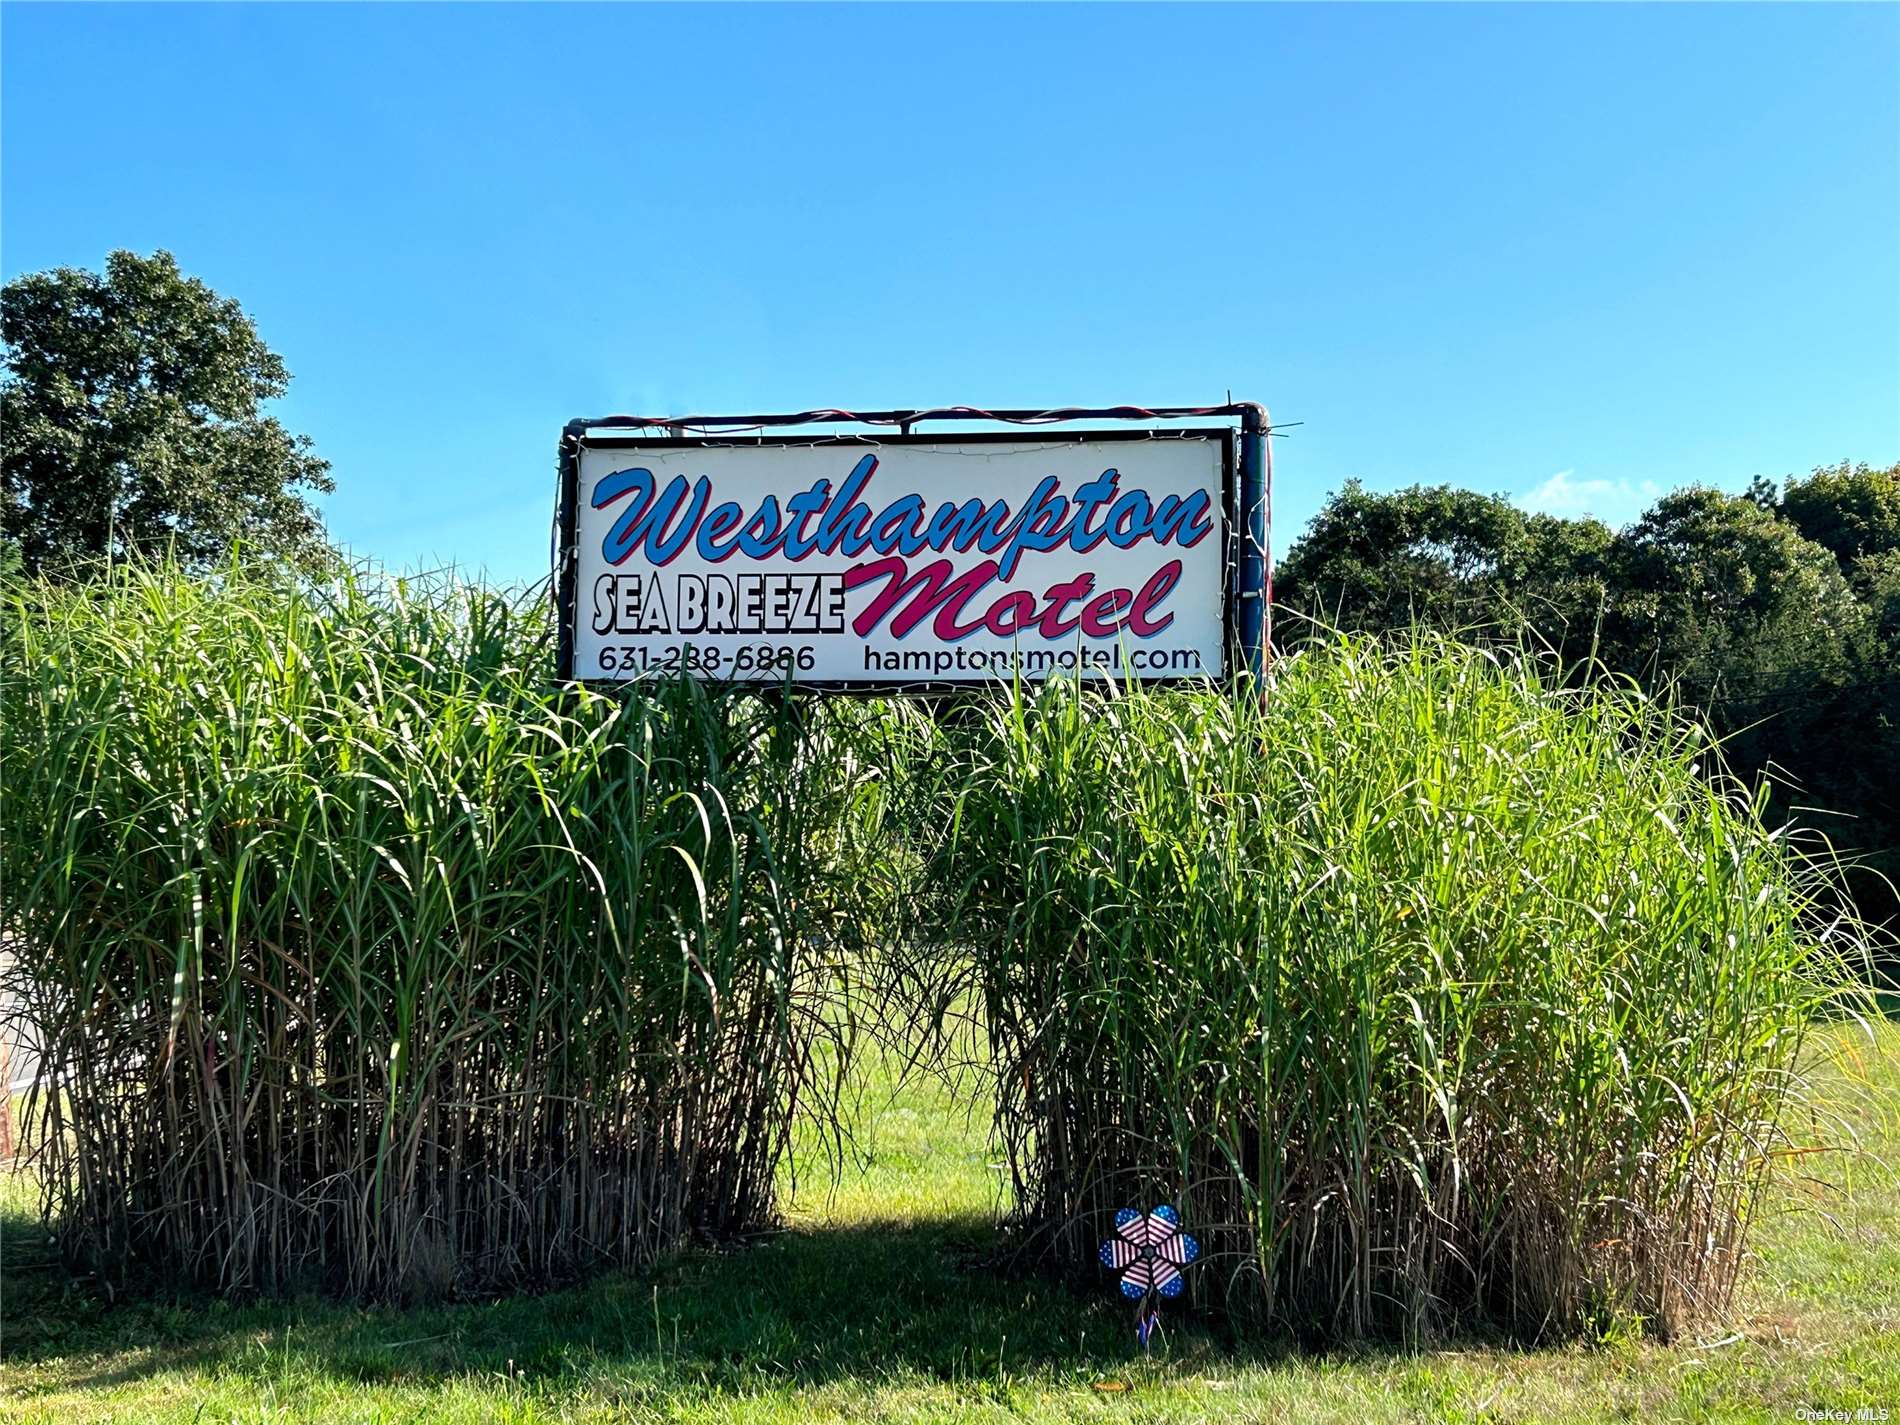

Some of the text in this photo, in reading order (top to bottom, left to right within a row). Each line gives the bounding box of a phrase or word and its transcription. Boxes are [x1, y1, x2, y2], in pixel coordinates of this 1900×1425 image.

[591, 454, 1214, 583] Westhampton
[592, 571, 845, 635] SEA BREEZE
[844, 556, 1183, 641] Motel
[599, 646, 815, 671] 631-288-6886
